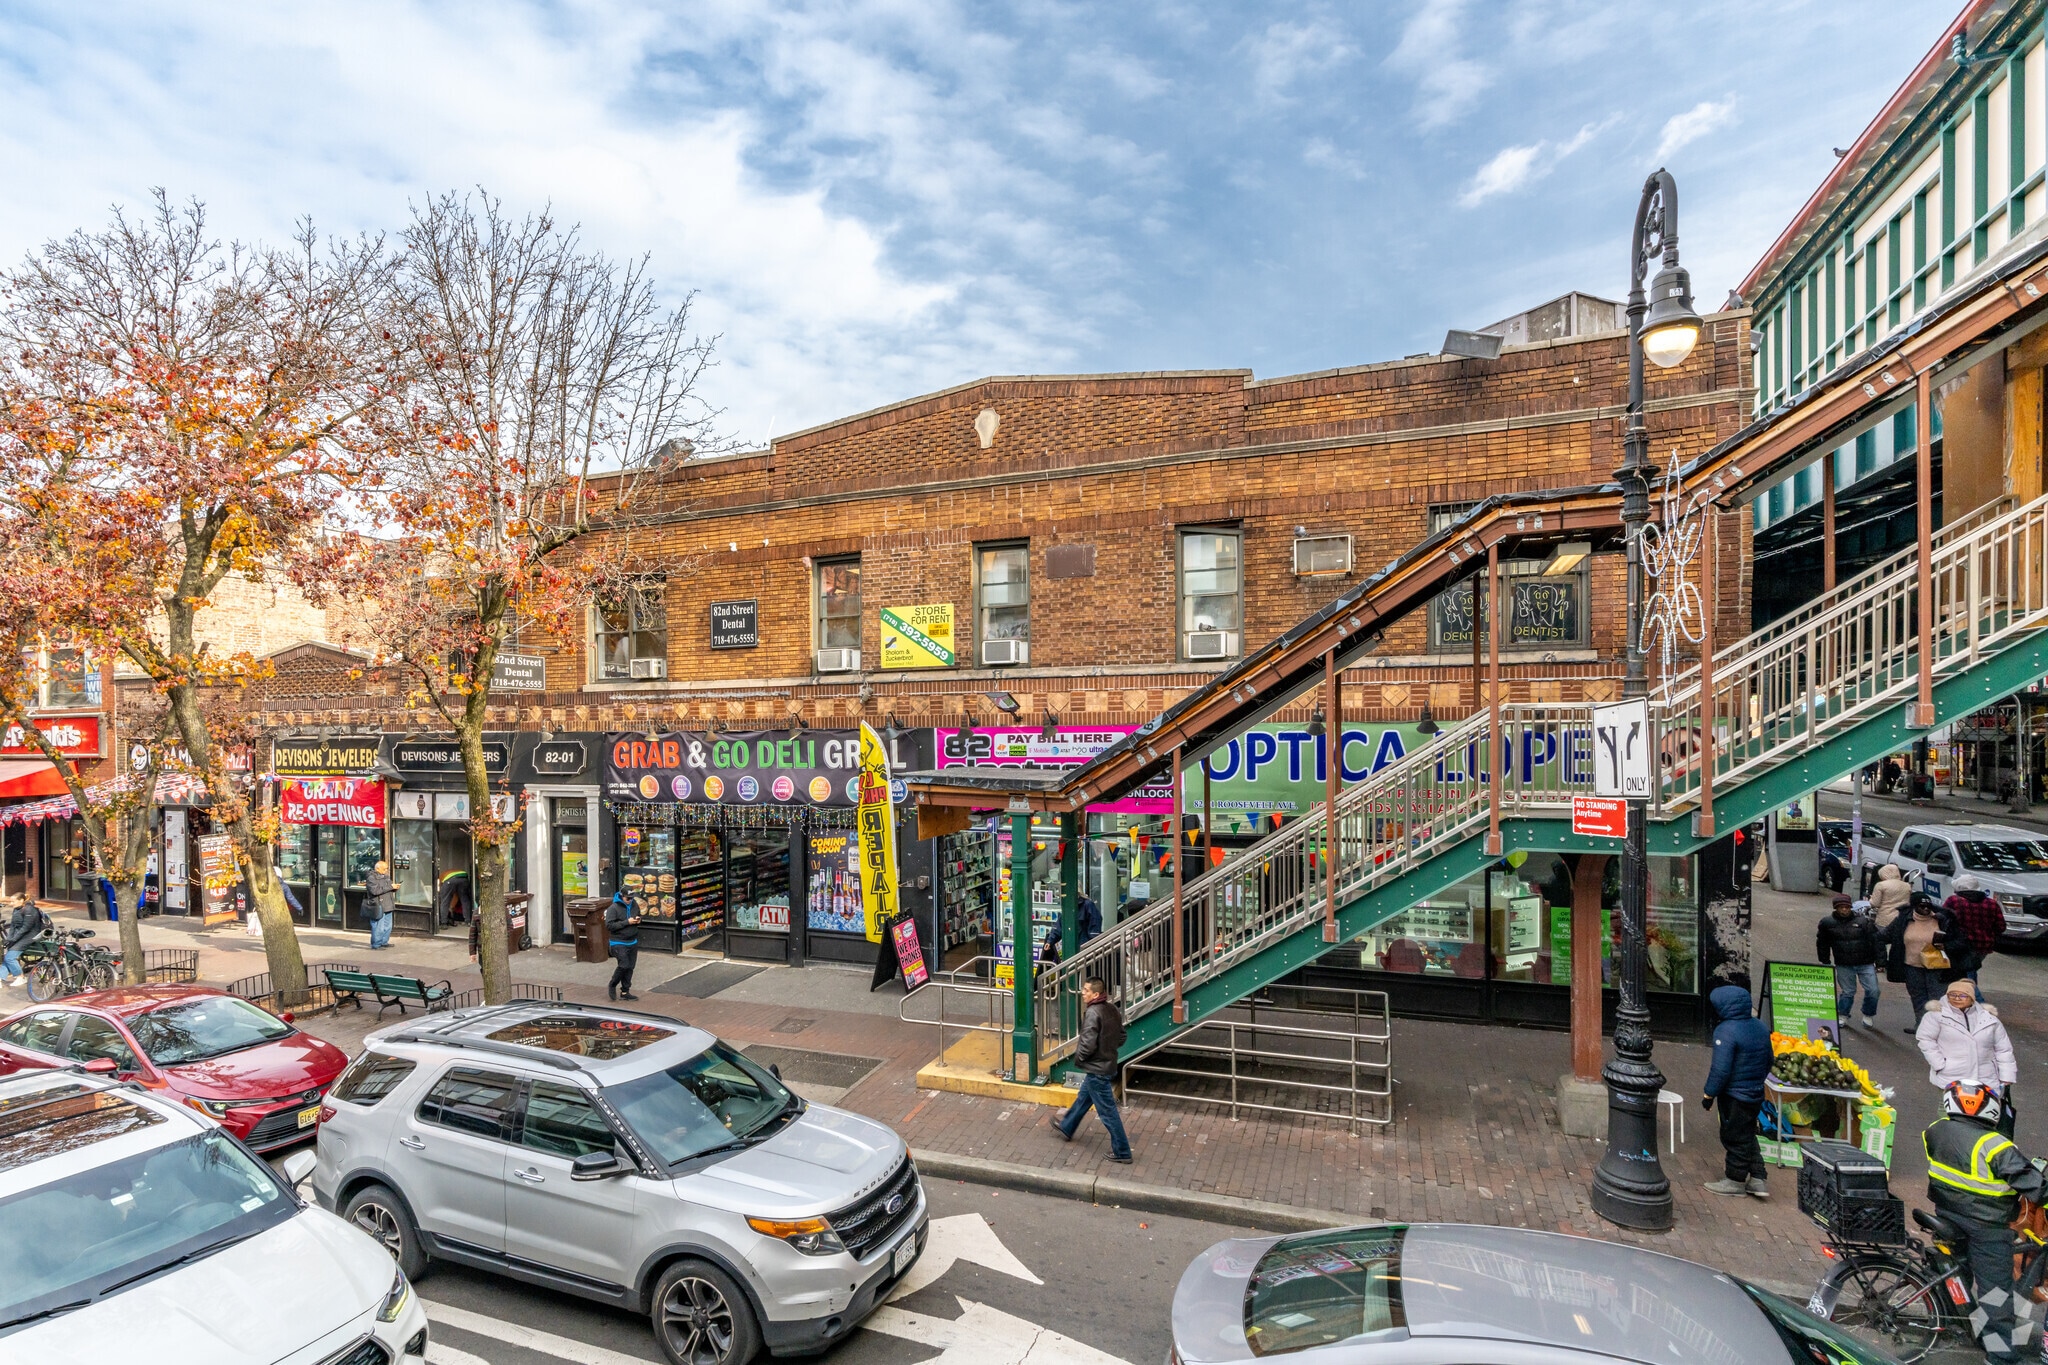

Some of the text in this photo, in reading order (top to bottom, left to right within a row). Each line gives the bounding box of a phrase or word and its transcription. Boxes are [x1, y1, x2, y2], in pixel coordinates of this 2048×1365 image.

[714, 605, 754, 616] 82nd Street
[915, 606, 947, 615] STORE
[722, 618, 746, 629] Dental
[911, 615, 951, 624] FOR RENT
[883, 614, 949, 660] (718) 392-5959
[1444, 631, 1491, 642] DENTST
[1513, 626, 1567, 638] DENTIST
[714, 634, 754, 645] 718-476-5555
[495, 655, 542, 667] 82nd Street
[505, 668, 533, 677] Dental
[495, 678, 543, 688] 718-476-5555
[1008, 734, 1113, 744] PAY BILL HERE
[944, 734, 992, 758] 82
[275, 748, 323, 767] DEVISONS
[401, 751, 448, 762] DEVISONS
[545, 752, 574, 763] 82-01
[613, 739, 907, 769] GRAB & GO DELI GRL
[1199, 729, 1412, 783] OPTICA
[1626, 776, 1647, 791] ONLY
[303, 781, 354, 800] GRAND
[1217, 800, 1275, 810] ROOSEVELT
[1276, 800, 1299, 810] AVE.
[1575, 800, 1618, 811] NO STANDING
[287, 802, 376, 824] RE-OPENING
[1576, 809, 1602, 819] Anytime
[811, 837, 847, 847] COMING
[816, 845, 841, 854] SOON
[761, 906, 789, 924] ATM
[898, 936, 919, 955] WE FIX
[901, 948, 921, 967] PHONES
[1789, 985, 1827, 993] CUALQUIER
[1795, 979, 1835, 988] DESCUENTO
[853, 1154, 903, 1198] EXPLORER
